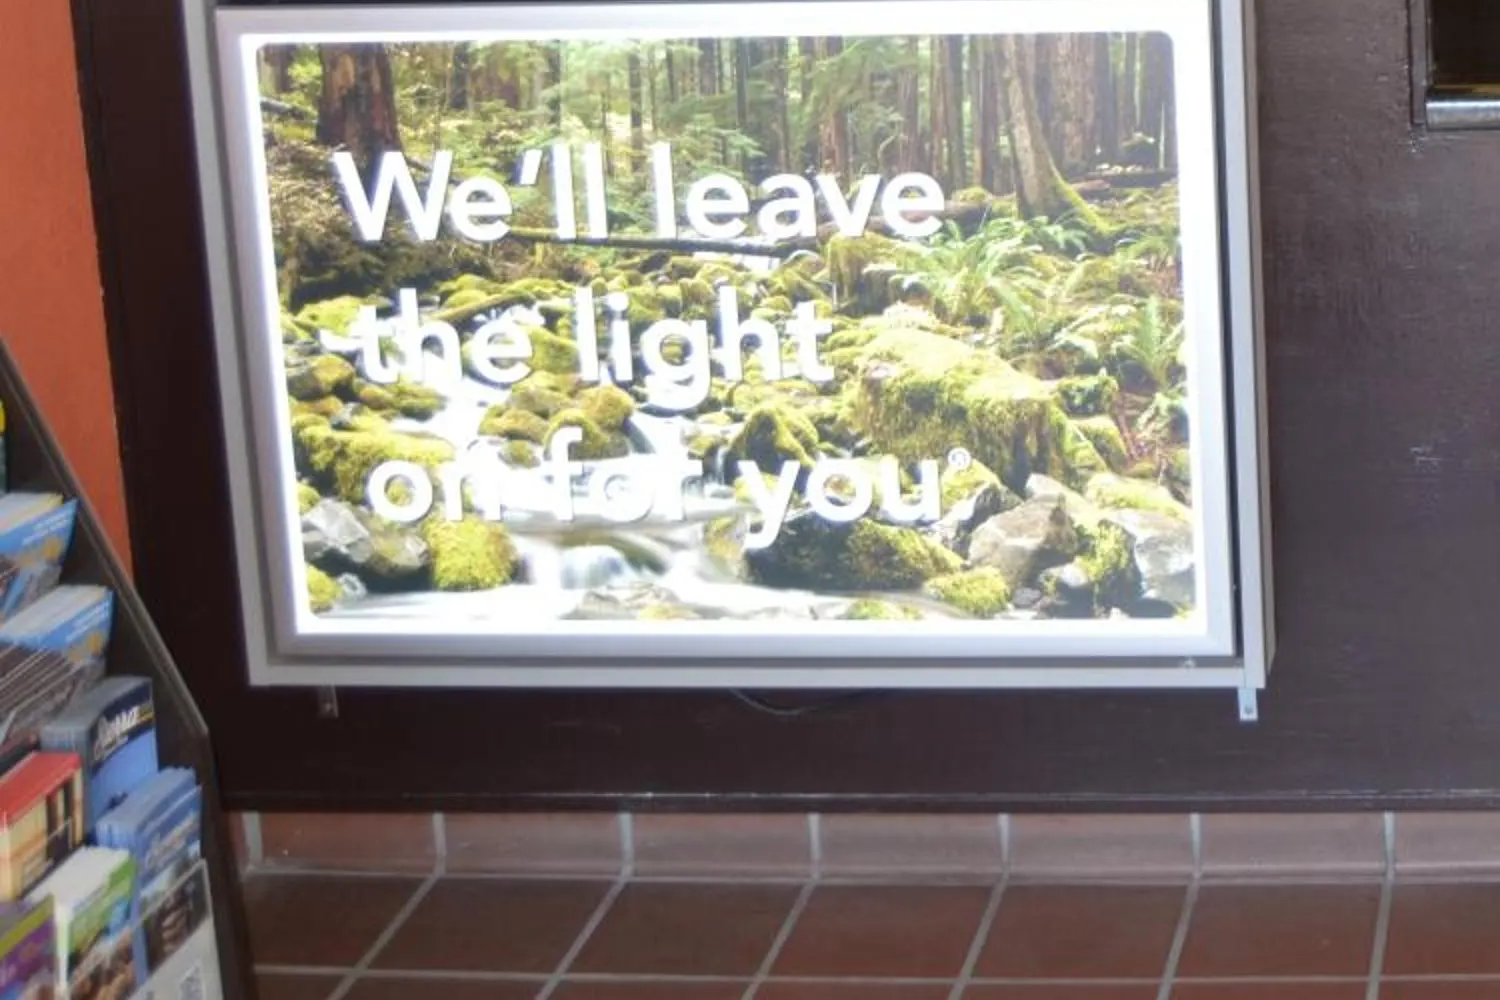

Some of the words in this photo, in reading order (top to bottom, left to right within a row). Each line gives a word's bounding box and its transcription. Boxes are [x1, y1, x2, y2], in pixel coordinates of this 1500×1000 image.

[652, 141, 945, 241] leave
[354, 287, 534, 386] the
[574, 285, 837, 412] light
[366, 456, 502, 523] on
[541, 426, 697, 523] for
